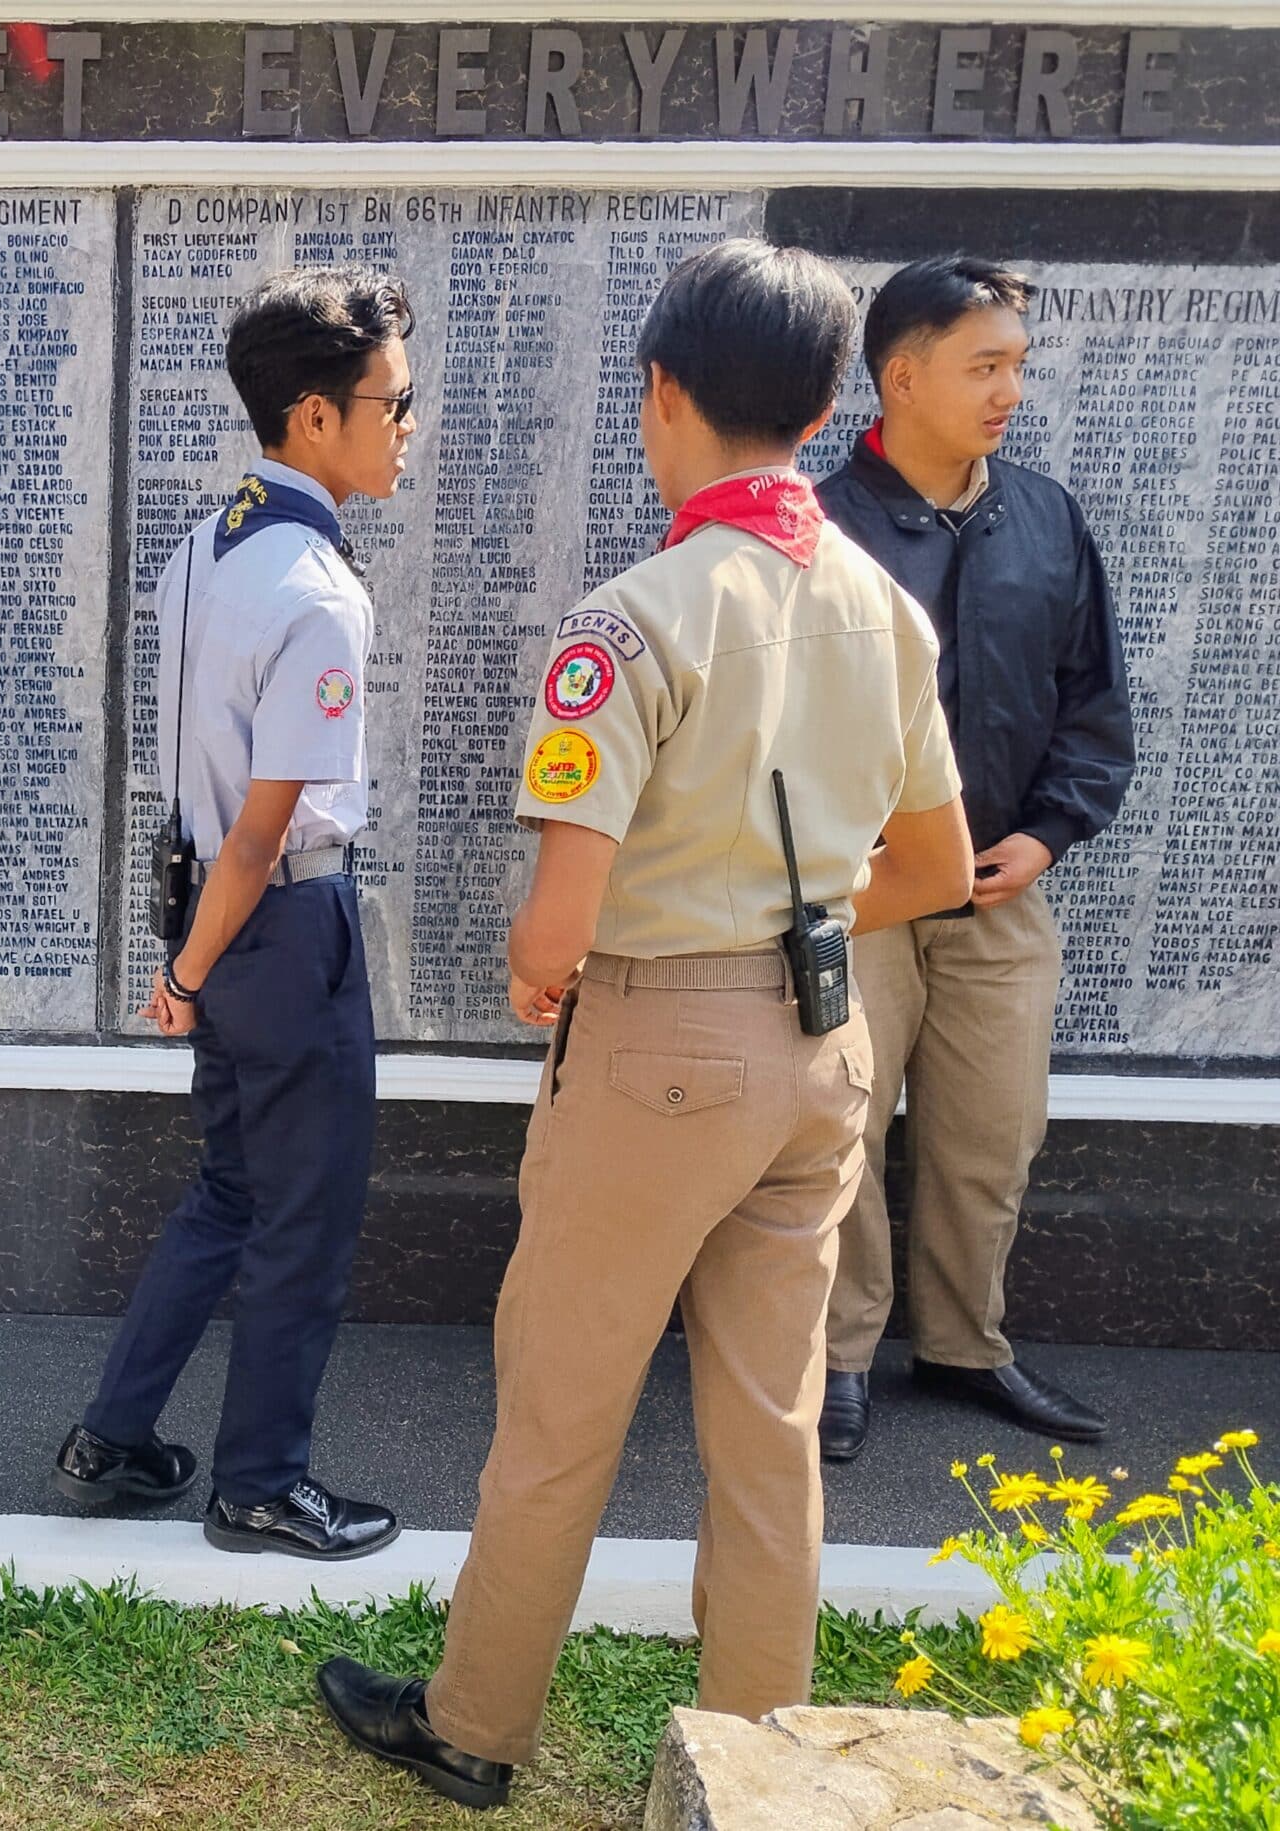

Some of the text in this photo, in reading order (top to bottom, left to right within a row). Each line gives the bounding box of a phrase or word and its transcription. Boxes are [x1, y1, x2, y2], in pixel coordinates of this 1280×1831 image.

[242, 22, 1181, 138] EVERYWHERE
[169, 198, 181, 225] D
[197, 198, 303, 225] COMPANY
[477, 196, 591, 223] INFANTRY
[143, 233, 258, 247] FIRST LIEUTENANT
[144, 249, 182, 261] TACAY
[609, 245, 683, 260] TILLO TINO
[190, 264, 233, 278] MATEO
[449, 278, 486, 292] IRVING
[1037, 287, 1174, 323] INFANTRY
[142, 311, 218, 325] AKIA DANIEL
[1144, 353, 1205, 366] MATHEW
[14, 373, 57, 387] BENITO
[1075, 415, 1133, 428] MANALO
[169, 434, 217, 447] BELARIO
[1132, 477, 1176, 491] SALES
[15, 507, 65, 521] VICENTE
[13, 622, 64, 636] BERNABE
[570, 615, 631, 645] BCNHS
[1162, 853, 1276, 866] VESAYA DELFIN
[1212, 868, 1267, 880] MARTIN
[21, 908, 66, 920] RAFAEL
